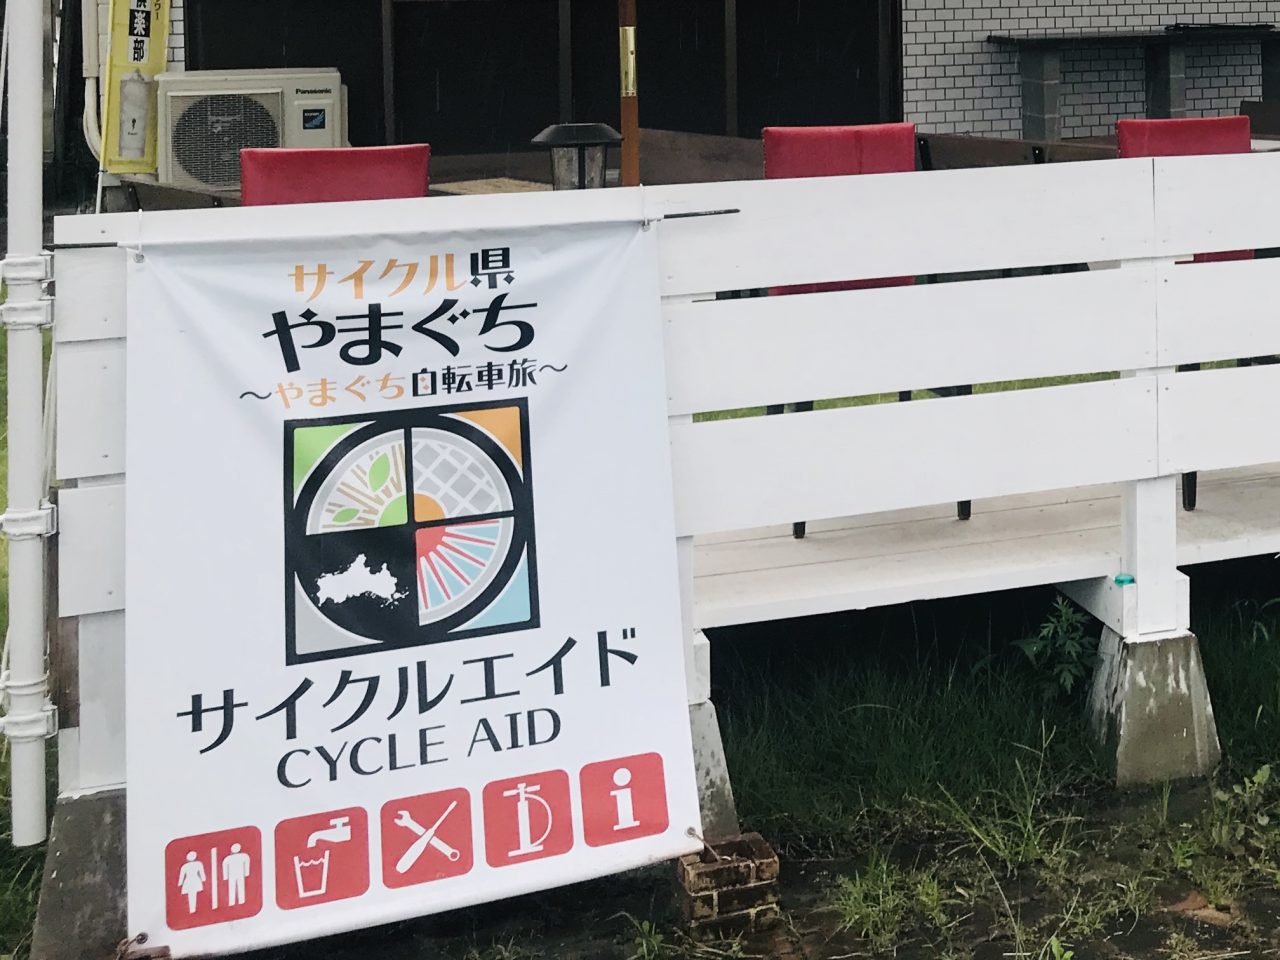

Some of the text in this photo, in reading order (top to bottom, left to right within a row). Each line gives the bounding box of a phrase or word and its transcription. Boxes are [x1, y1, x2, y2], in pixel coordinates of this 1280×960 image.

[288, 247, 514, 302] サイクル県
[262, 292, 538, 373] やまぐち
[176, 627, 638, 755] サイクルエイド
[276, 707, 562, 789] CYCLE AID
